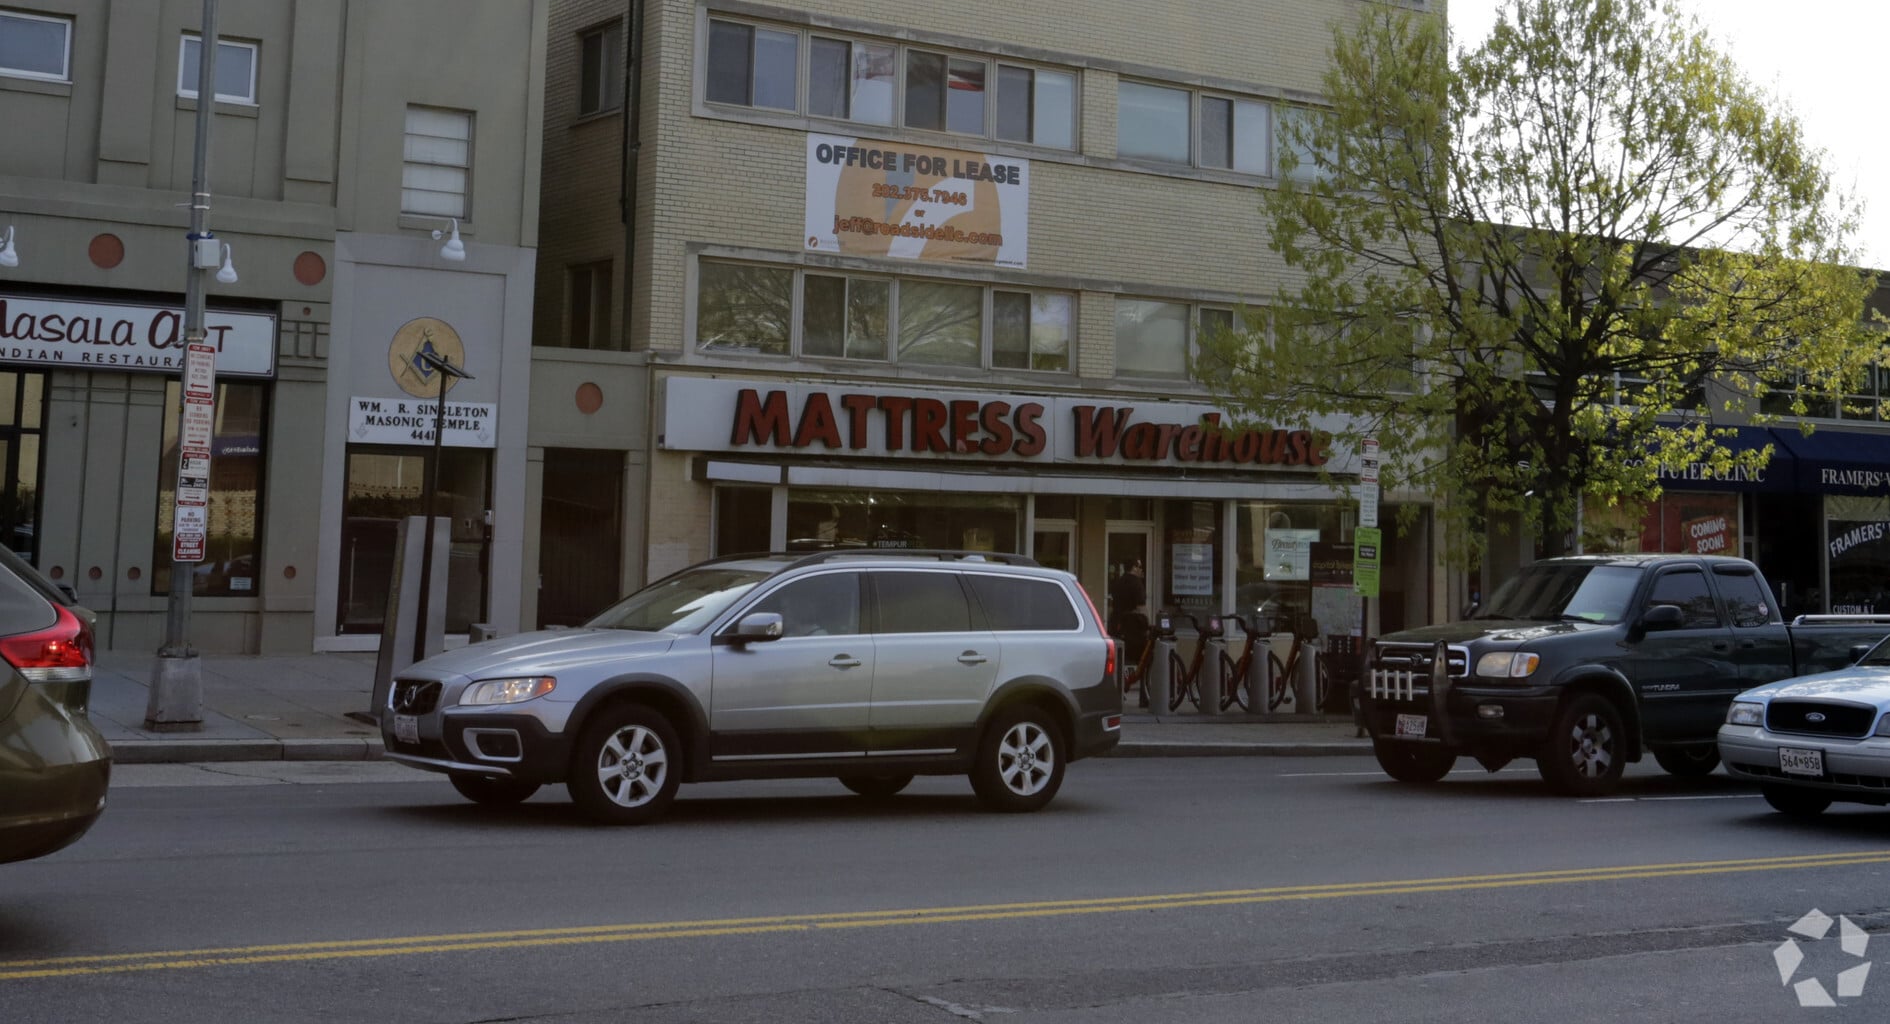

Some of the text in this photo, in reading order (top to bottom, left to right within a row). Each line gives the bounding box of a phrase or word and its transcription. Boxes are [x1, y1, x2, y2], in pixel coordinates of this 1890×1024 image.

[816, 143, 1020, 186] OFFICE FOR LEASE
[914, 208, 925, 218] or
[832, 215, 1003, 247] jeff@roadsidellc.com
[82, 352, 186, 368] RESTAURA
[359, 401, 388, 413] WM.
[398, 403, 410, 414] R.
[366, 415, 480, 431] MASONIC TEMPLE
[731, 387, 1332, 466] MATTRESS Warehouse
[410, 429, 435, 441] 4441
[1691, 517, 1726, 538] COMING
[1697, 533, 1725, 554] SOON!
